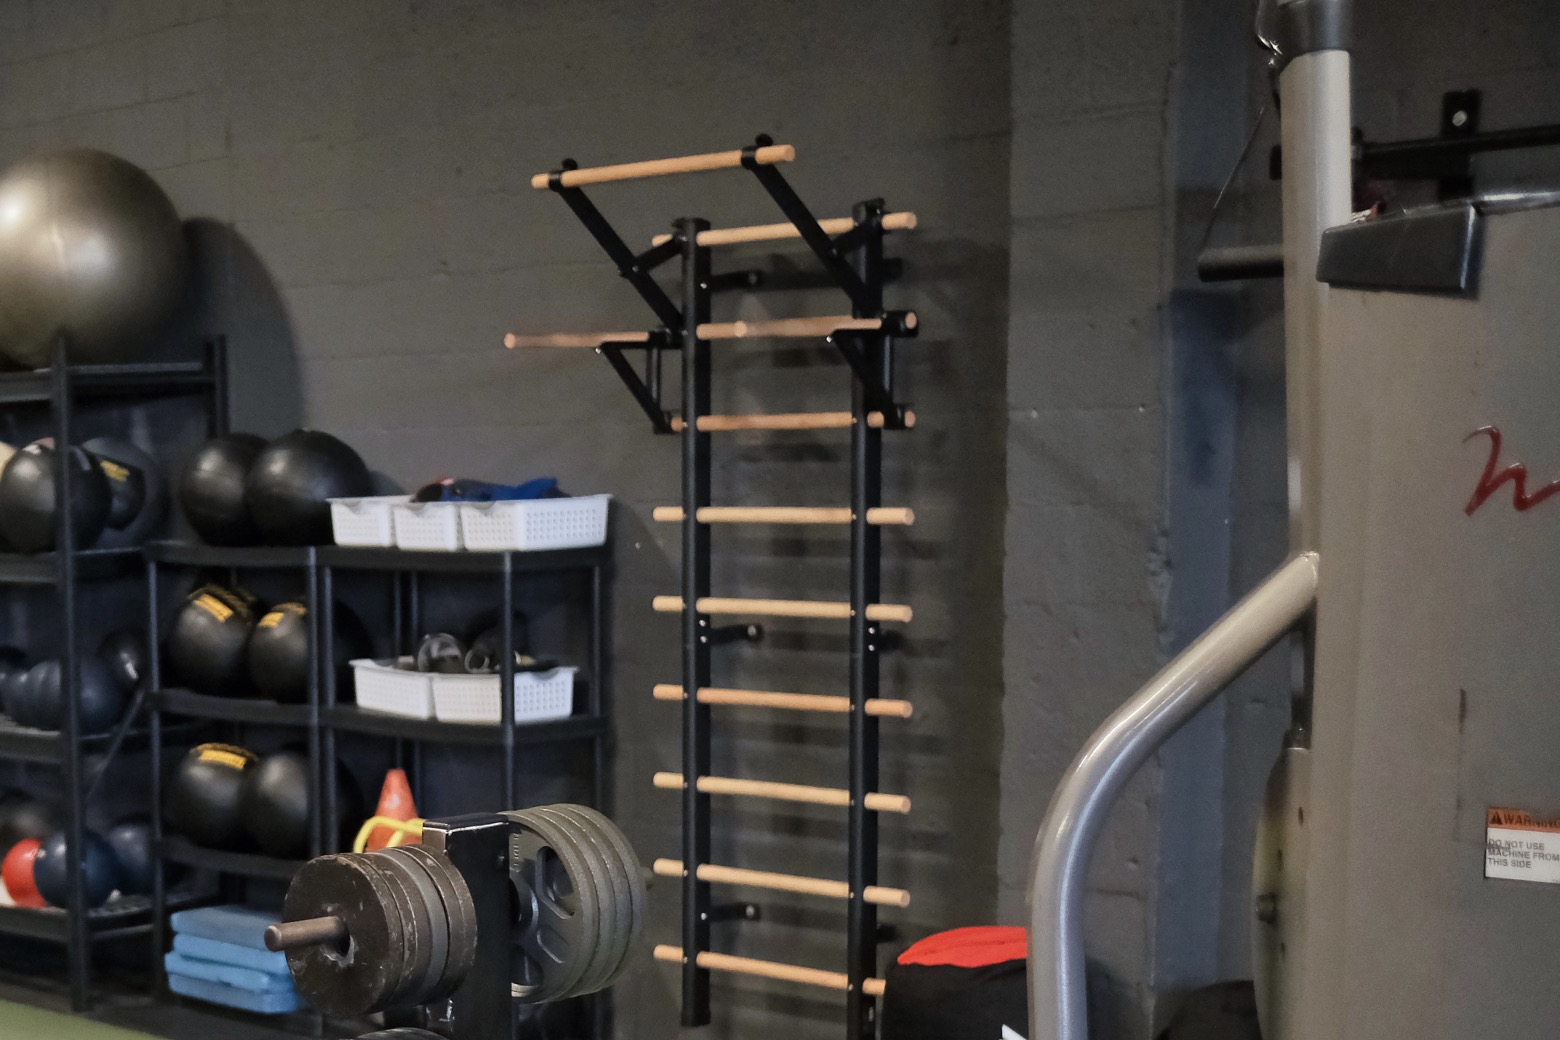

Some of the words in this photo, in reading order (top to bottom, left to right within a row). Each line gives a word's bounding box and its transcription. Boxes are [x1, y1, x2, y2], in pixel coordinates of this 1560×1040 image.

[1505, 840, 1523, 849] NOT
[1526, 842, 1544, 850] USE
[1488, 848, 1530, 859] MACHINE
[1533, 852, 1560, 861] FROM
[1488, 857, 1508, 866] THIS
[1511, 860, 1531, 868] SIDE
